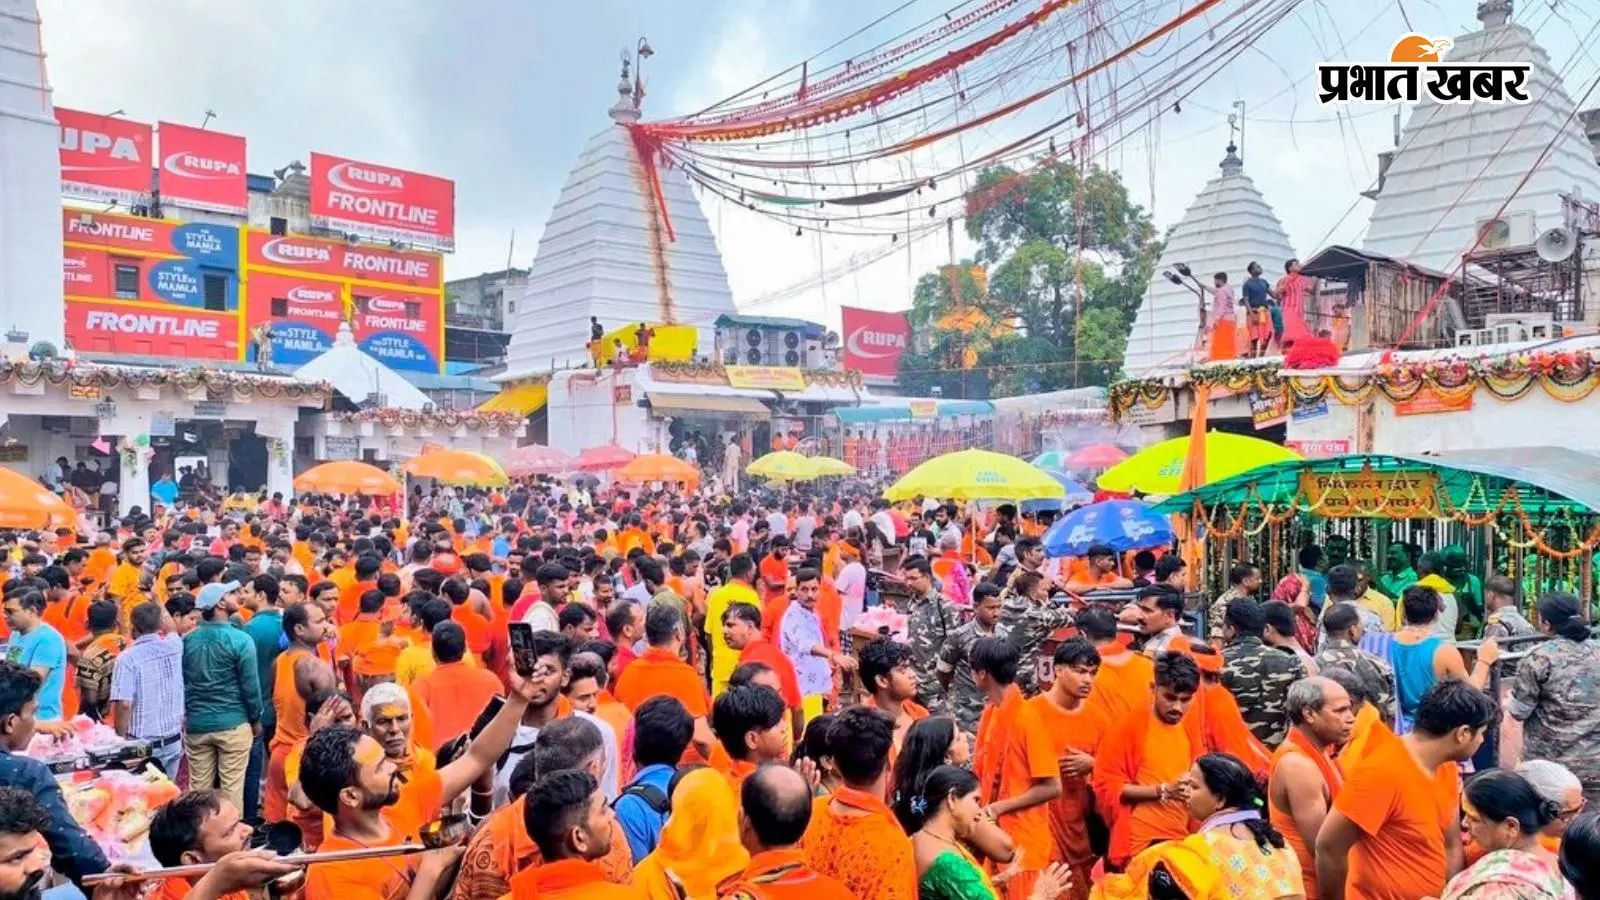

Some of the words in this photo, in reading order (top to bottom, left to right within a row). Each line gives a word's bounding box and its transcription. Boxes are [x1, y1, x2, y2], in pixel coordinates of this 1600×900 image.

[57, 126, 142, 163] UPA
[183, 154, 241, 175] RUPA
[347, 166, 404, 189] RUPA
[327, 191, 440, 226] FRONTLINE
[186, 241, 222, 251] MAMLA
[277, 243, 331, 261] RUPA
[342, 251, 429, 278] FRONTLINE
[158, 271, 188, 283] STYLE
[157, 281, 198, 294] MAMLA
[297, 289, 335, 302] RUPA
[287, 306, 339, 320] FRONTLINE
[85, 310, 221, 339] FRONTLINE
[364, 315, 427, 333] FRONTLINE
[287, 327, 319, 340] STYLE
[862, 330, 907, 349] RUPA
[284, 339, 322, 352] MAMLA
[382, 337, 409, 348] STYLE
[378, 347, 414, 360] MAMLA
